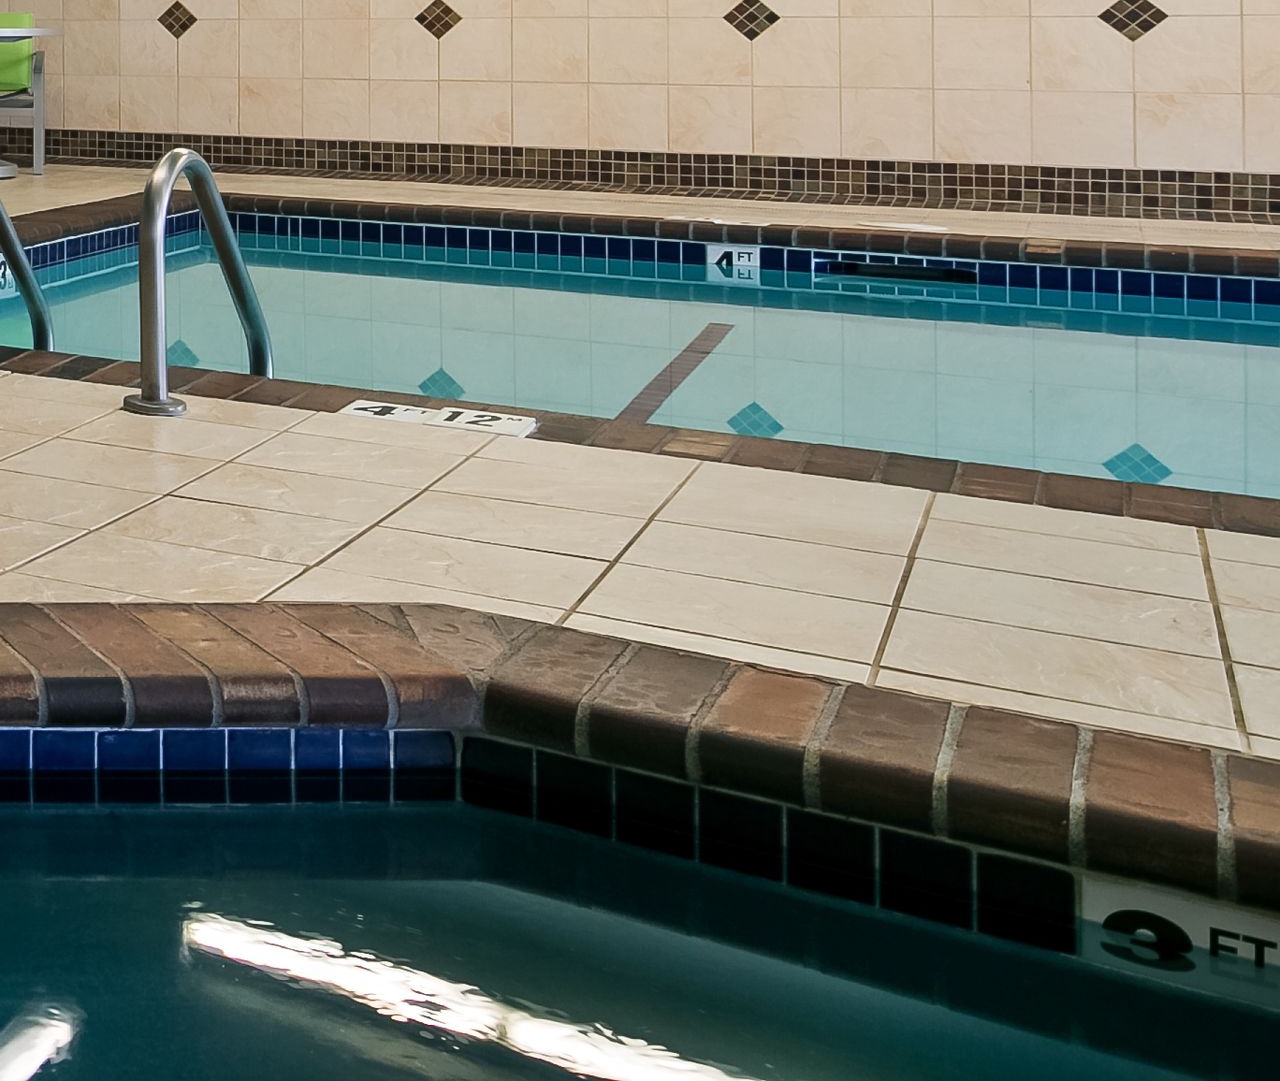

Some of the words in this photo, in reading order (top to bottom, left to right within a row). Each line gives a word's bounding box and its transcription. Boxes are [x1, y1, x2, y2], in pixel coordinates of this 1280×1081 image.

[738, 251, 753, 262] FT
[353, 405, 398, 417] 4
[1209, 926, 1278, 968] FT
